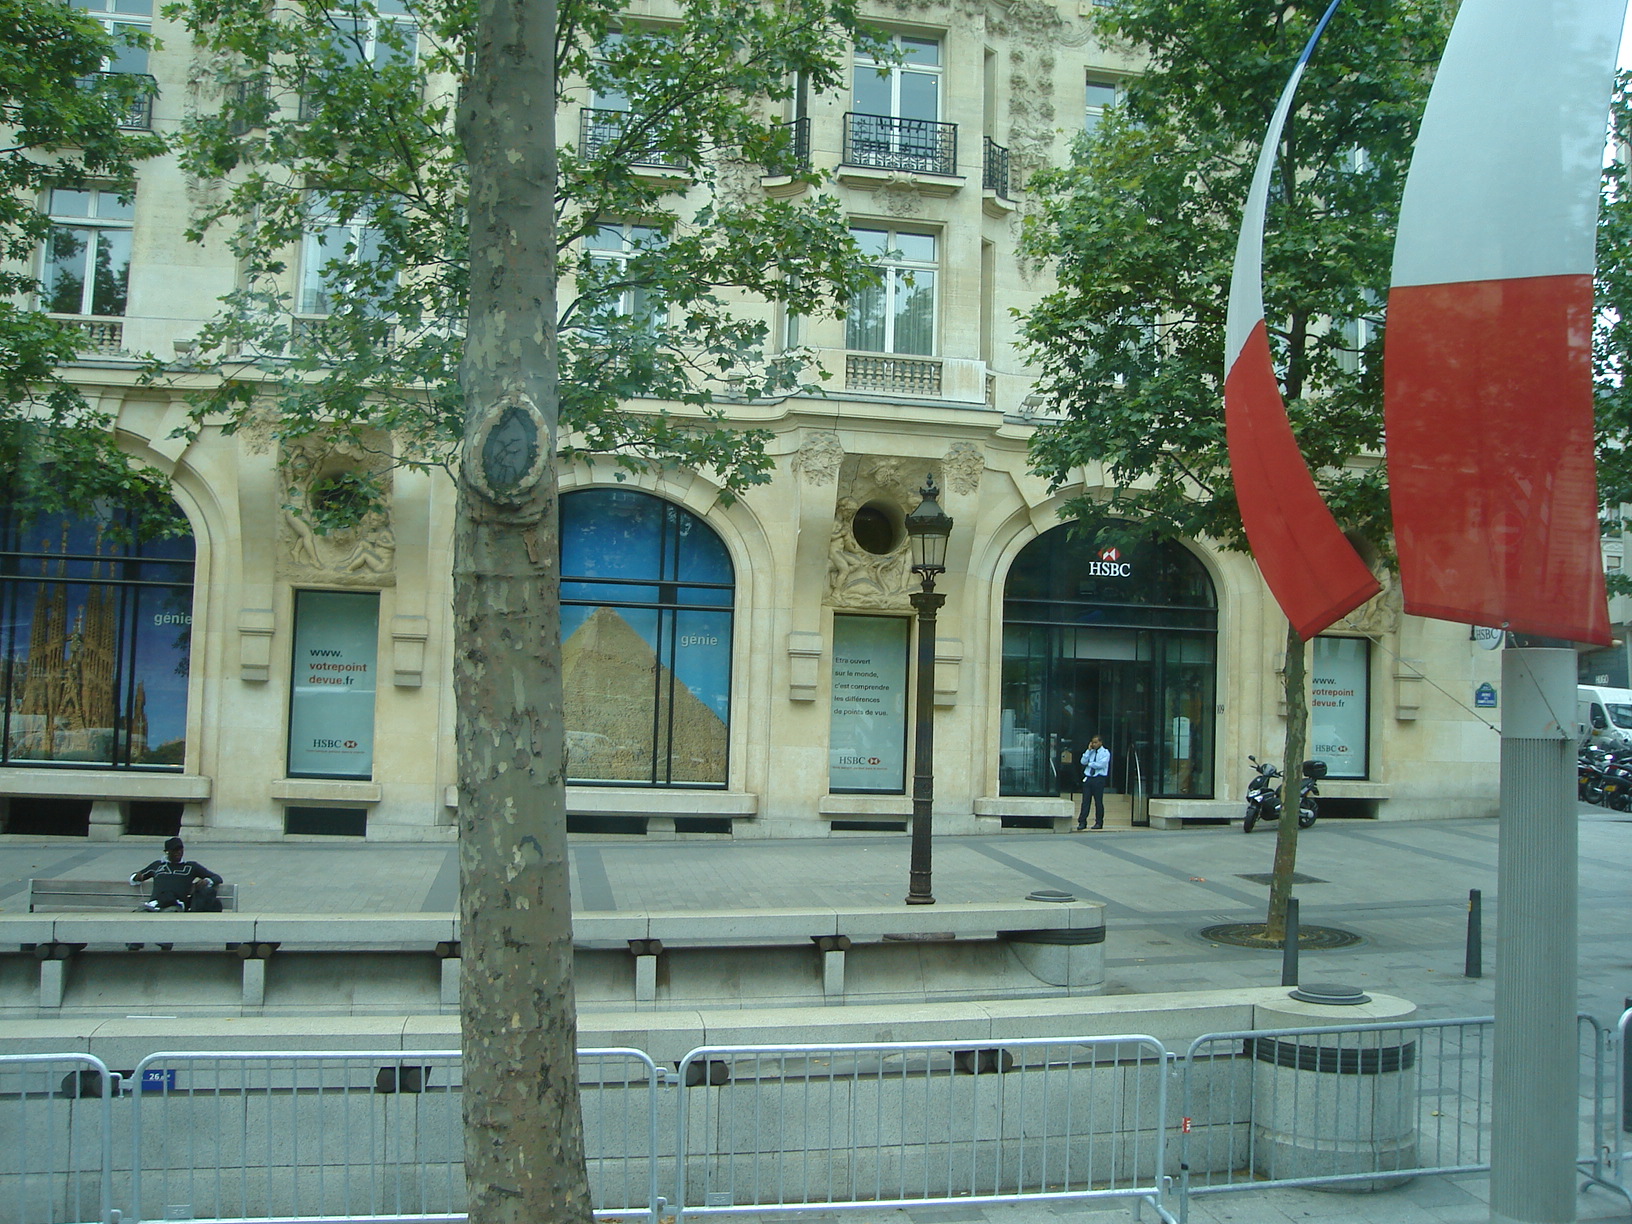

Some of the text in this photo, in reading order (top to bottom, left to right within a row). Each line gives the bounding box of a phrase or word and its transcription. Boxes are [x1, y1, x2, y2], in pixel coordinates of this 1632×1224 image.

[1088, 561, 1131, 577] HSBC
[154, 611, 193, 626] génie
[681, 632, 718, 647] génie
[310, 649, 343, 658] www.
[309, 662, 367, 673] votrepoint
[854, 671, 879, 679] monde,
[308, 675, 354, 685] devue.fr
[1312, 688, 1354, 697] votrepoint
[1312, 698, 1345, 708] devue.fr
[313, 739, 342, 748] HSBC
[1315, 744, 1337, 753] HSBC
[839, 756, 866, 765] HSBC
